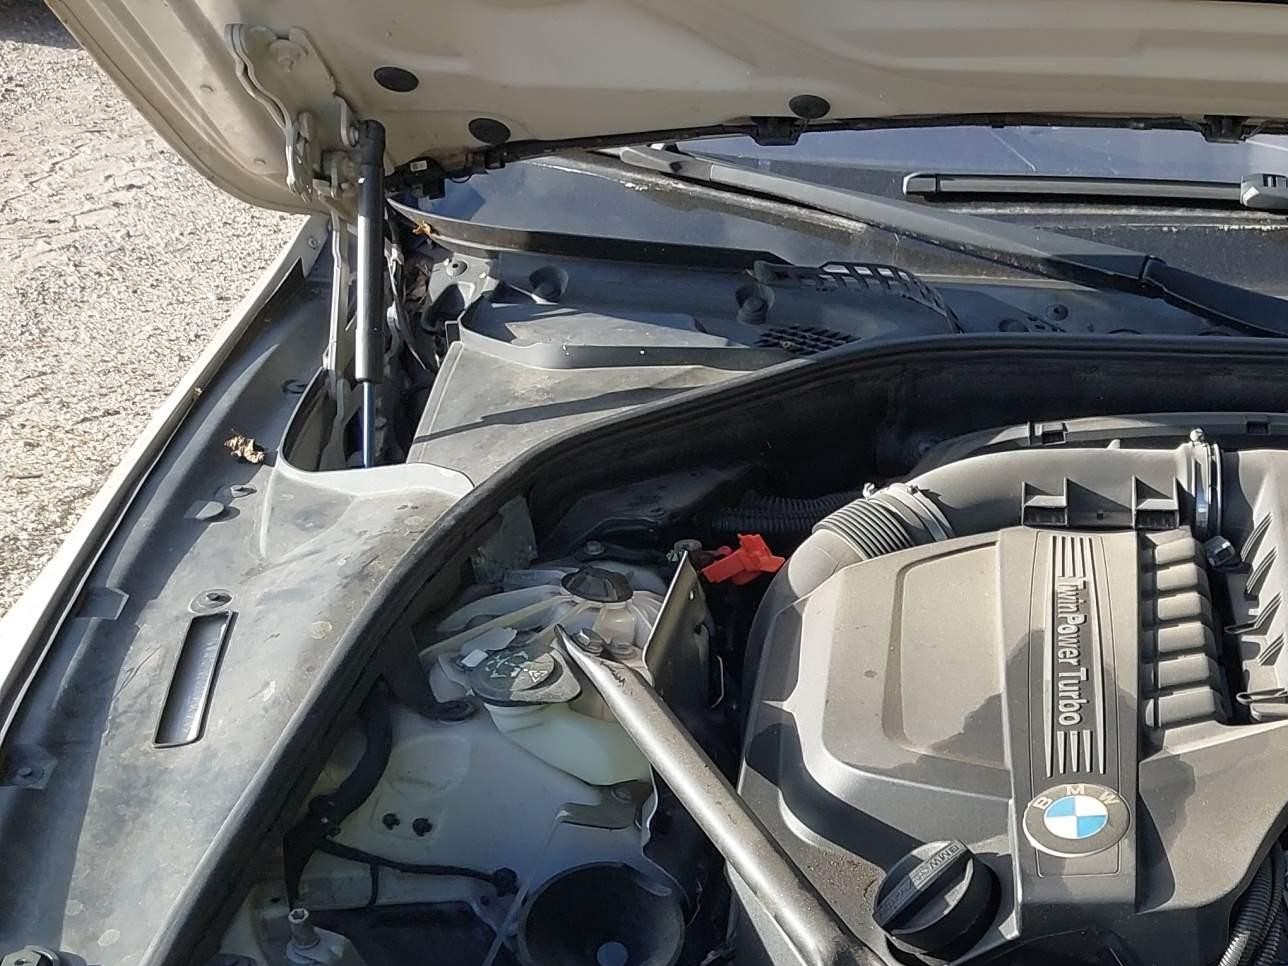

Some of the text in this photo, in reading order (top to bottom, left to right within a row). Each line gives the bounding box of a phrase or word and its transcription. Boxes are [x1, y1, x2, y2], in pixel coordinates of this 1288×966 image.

[1057, 575, 1089, 726] TwinPower Turbo
[1032, 784, 1121, 810] BMW
